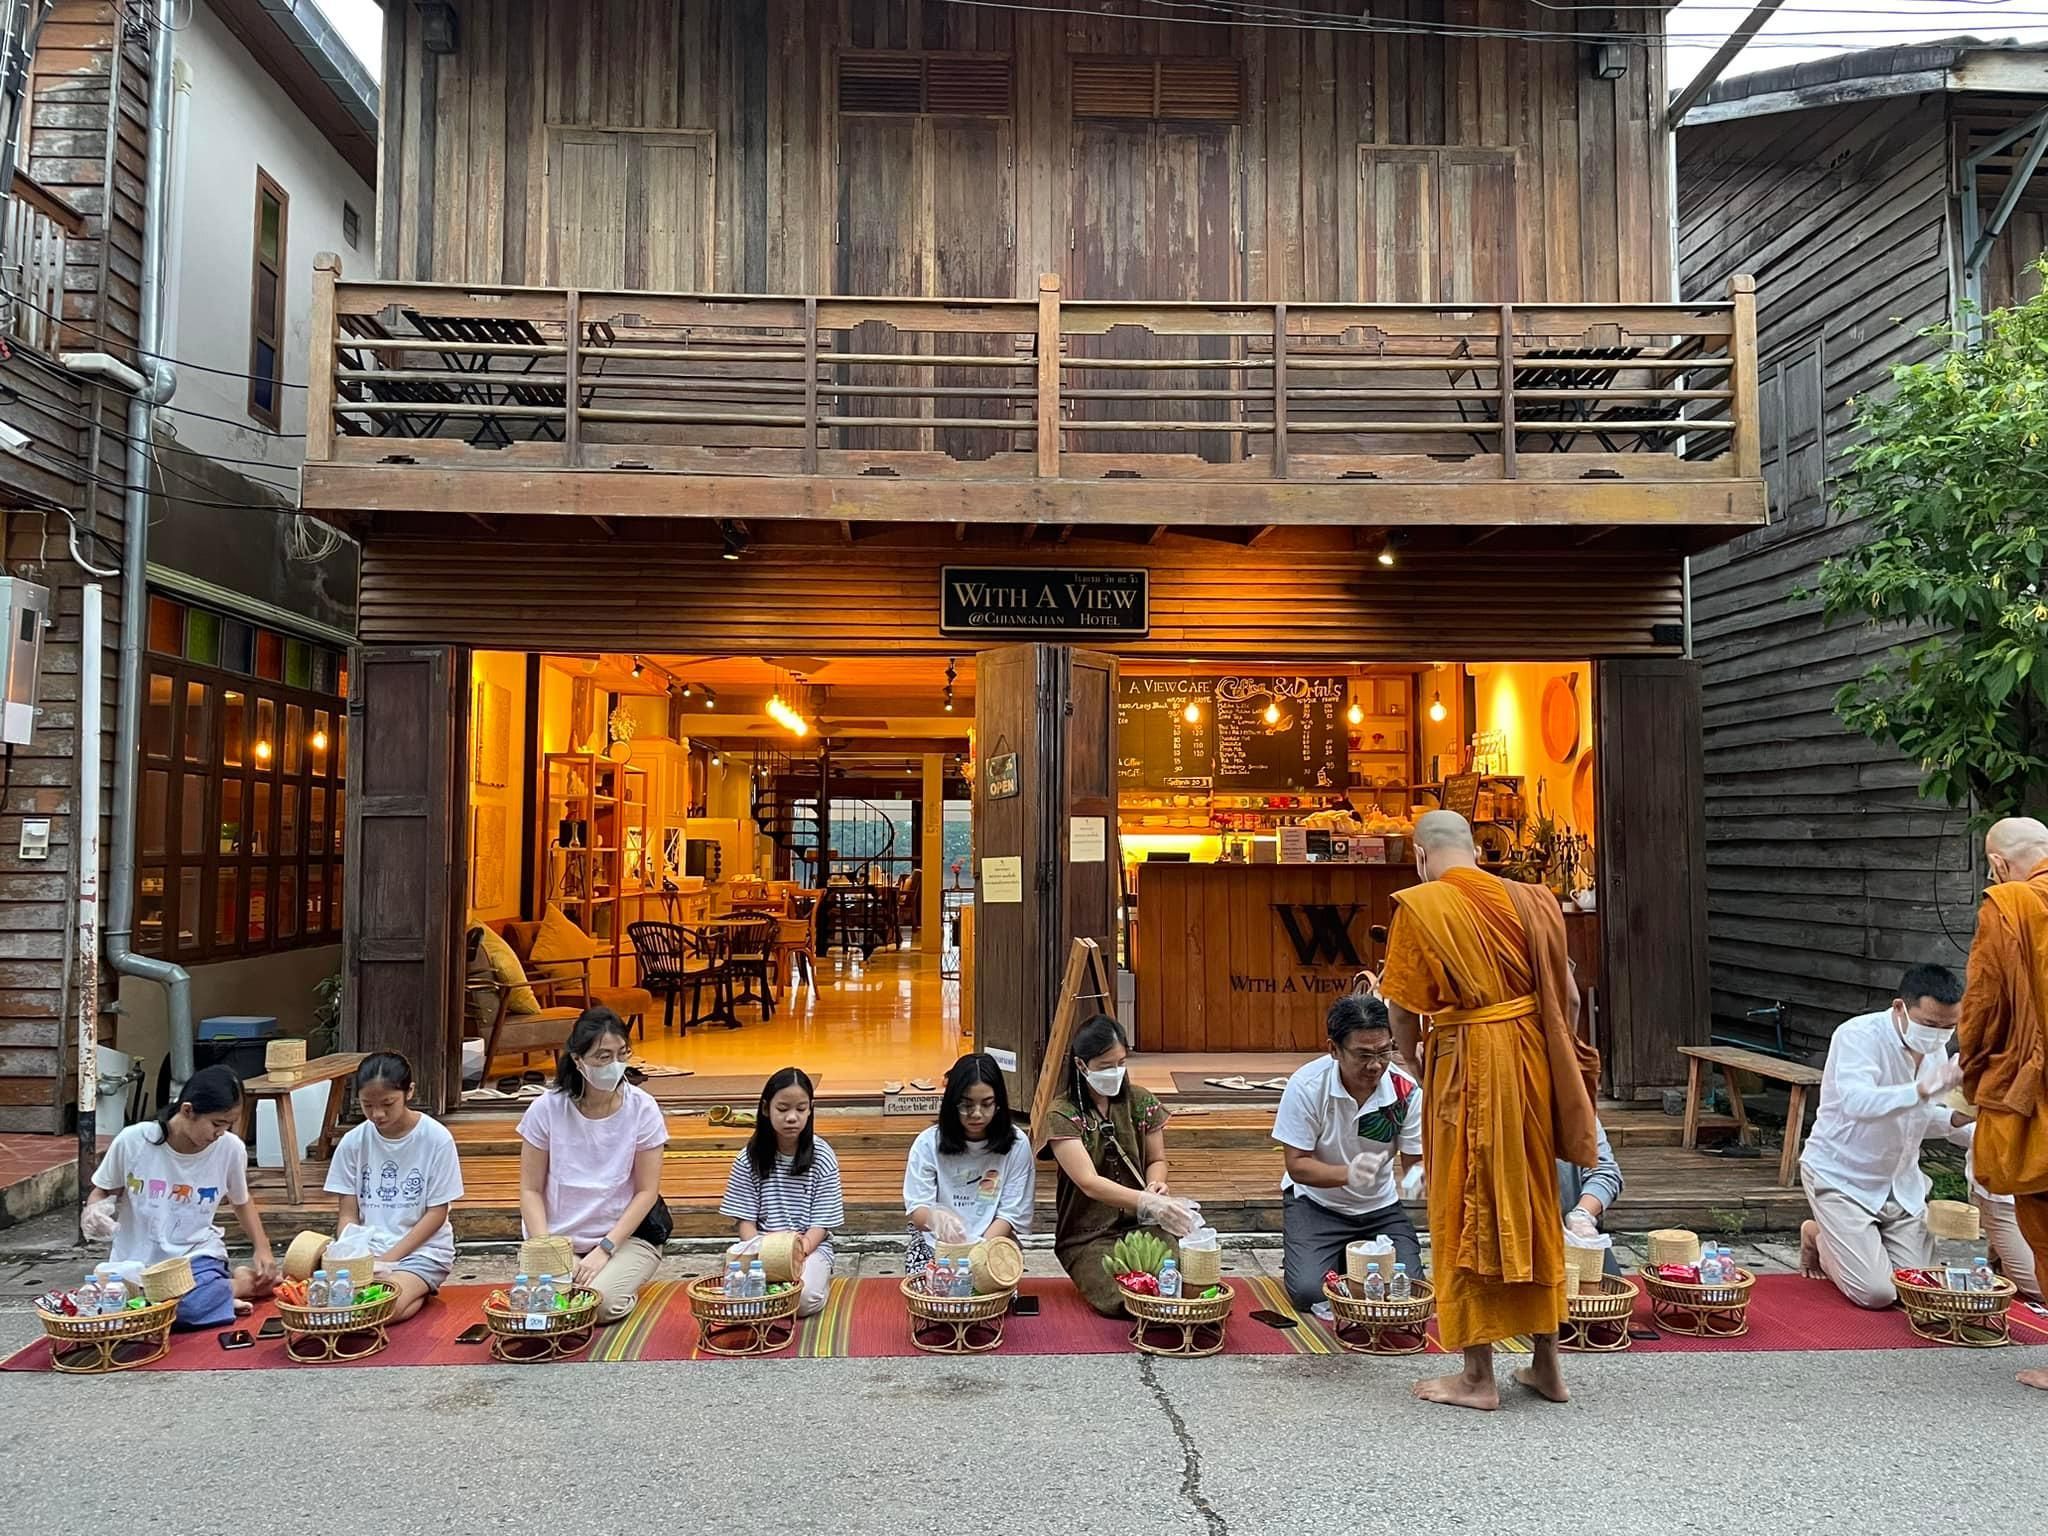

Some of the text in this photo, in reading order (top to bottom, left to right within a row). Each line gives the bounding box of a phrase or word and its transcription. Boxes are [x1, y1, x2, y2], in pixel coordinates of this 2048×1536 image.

[1036, 584, 1059, 608] A
[1129, 681, 1141, 694] A
[990, 779, 1014, 796] OPEN
[1282, 976, 1297, 993] A
[888, 1103, 912, 1112] Please
